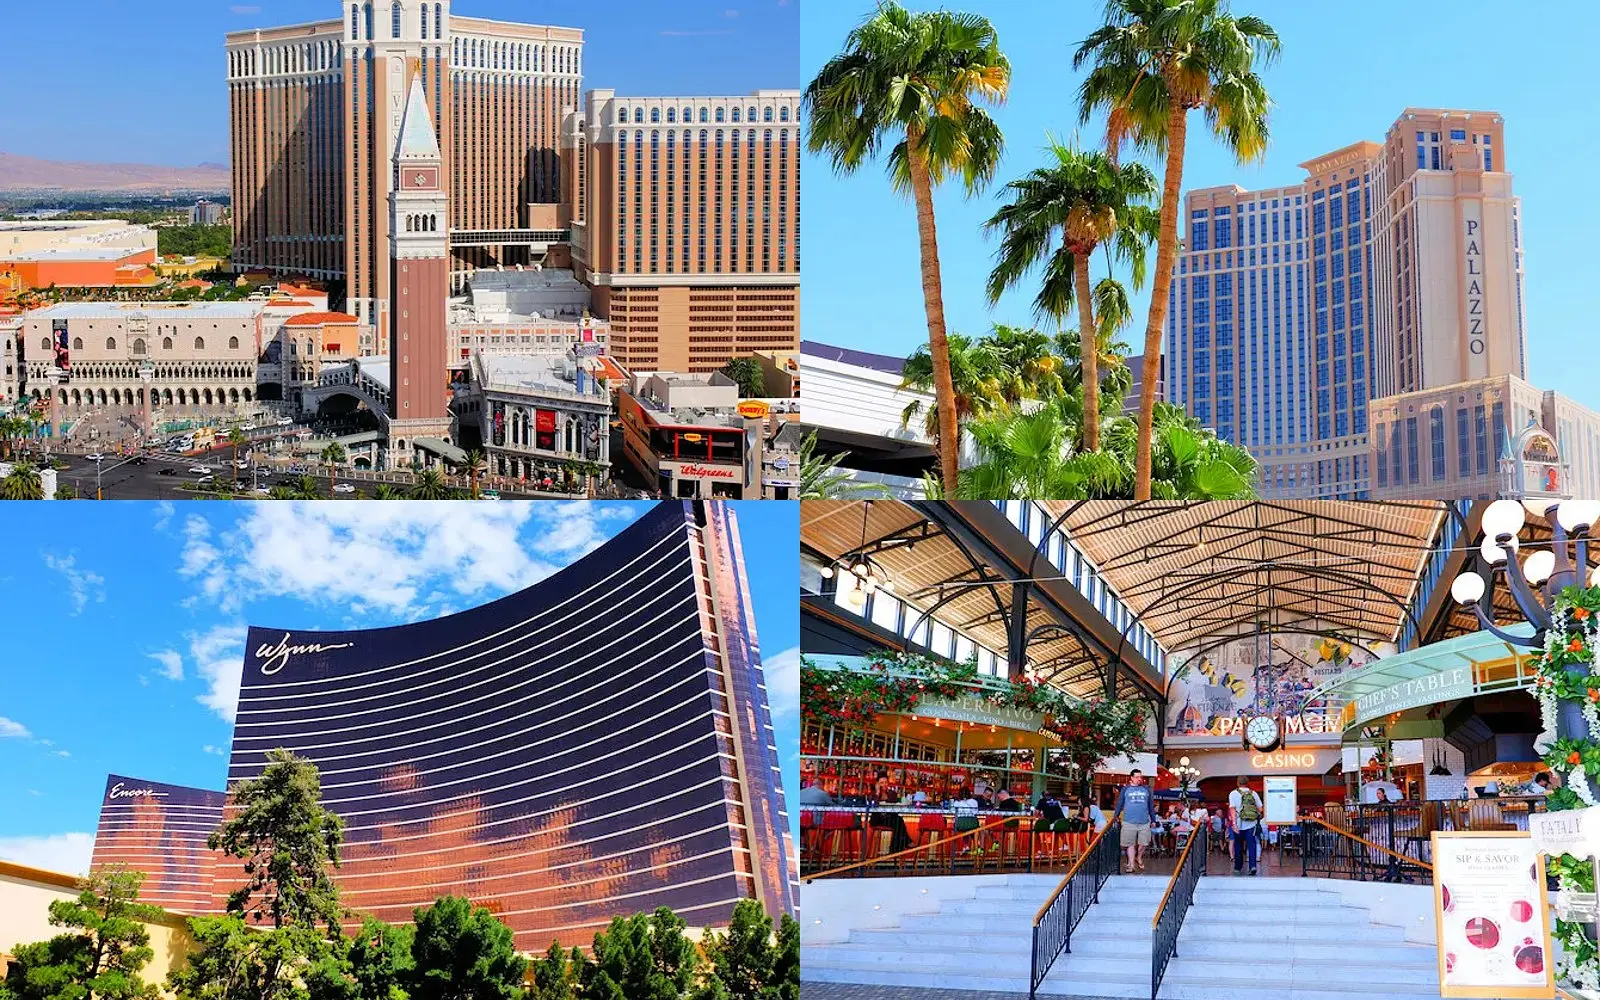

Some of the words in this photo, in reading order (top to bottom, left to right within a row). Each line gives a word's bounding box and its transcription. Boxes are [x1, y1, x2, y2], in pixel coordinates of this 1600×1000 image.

[1466, 220, 1485, 355] PALAZZO
[1358, 685, 1399, 710] CHEF'S
[1402, 669, 1465, 694] TABLE
[1251, 753, 1316, 768] CASINO
[110, 782, 169, 799] Encore
[1456, 854, 1472, 864] SIP
[1474, 854, 1482, 863] &
[1486, 854, 1520, 864] SAVOR
